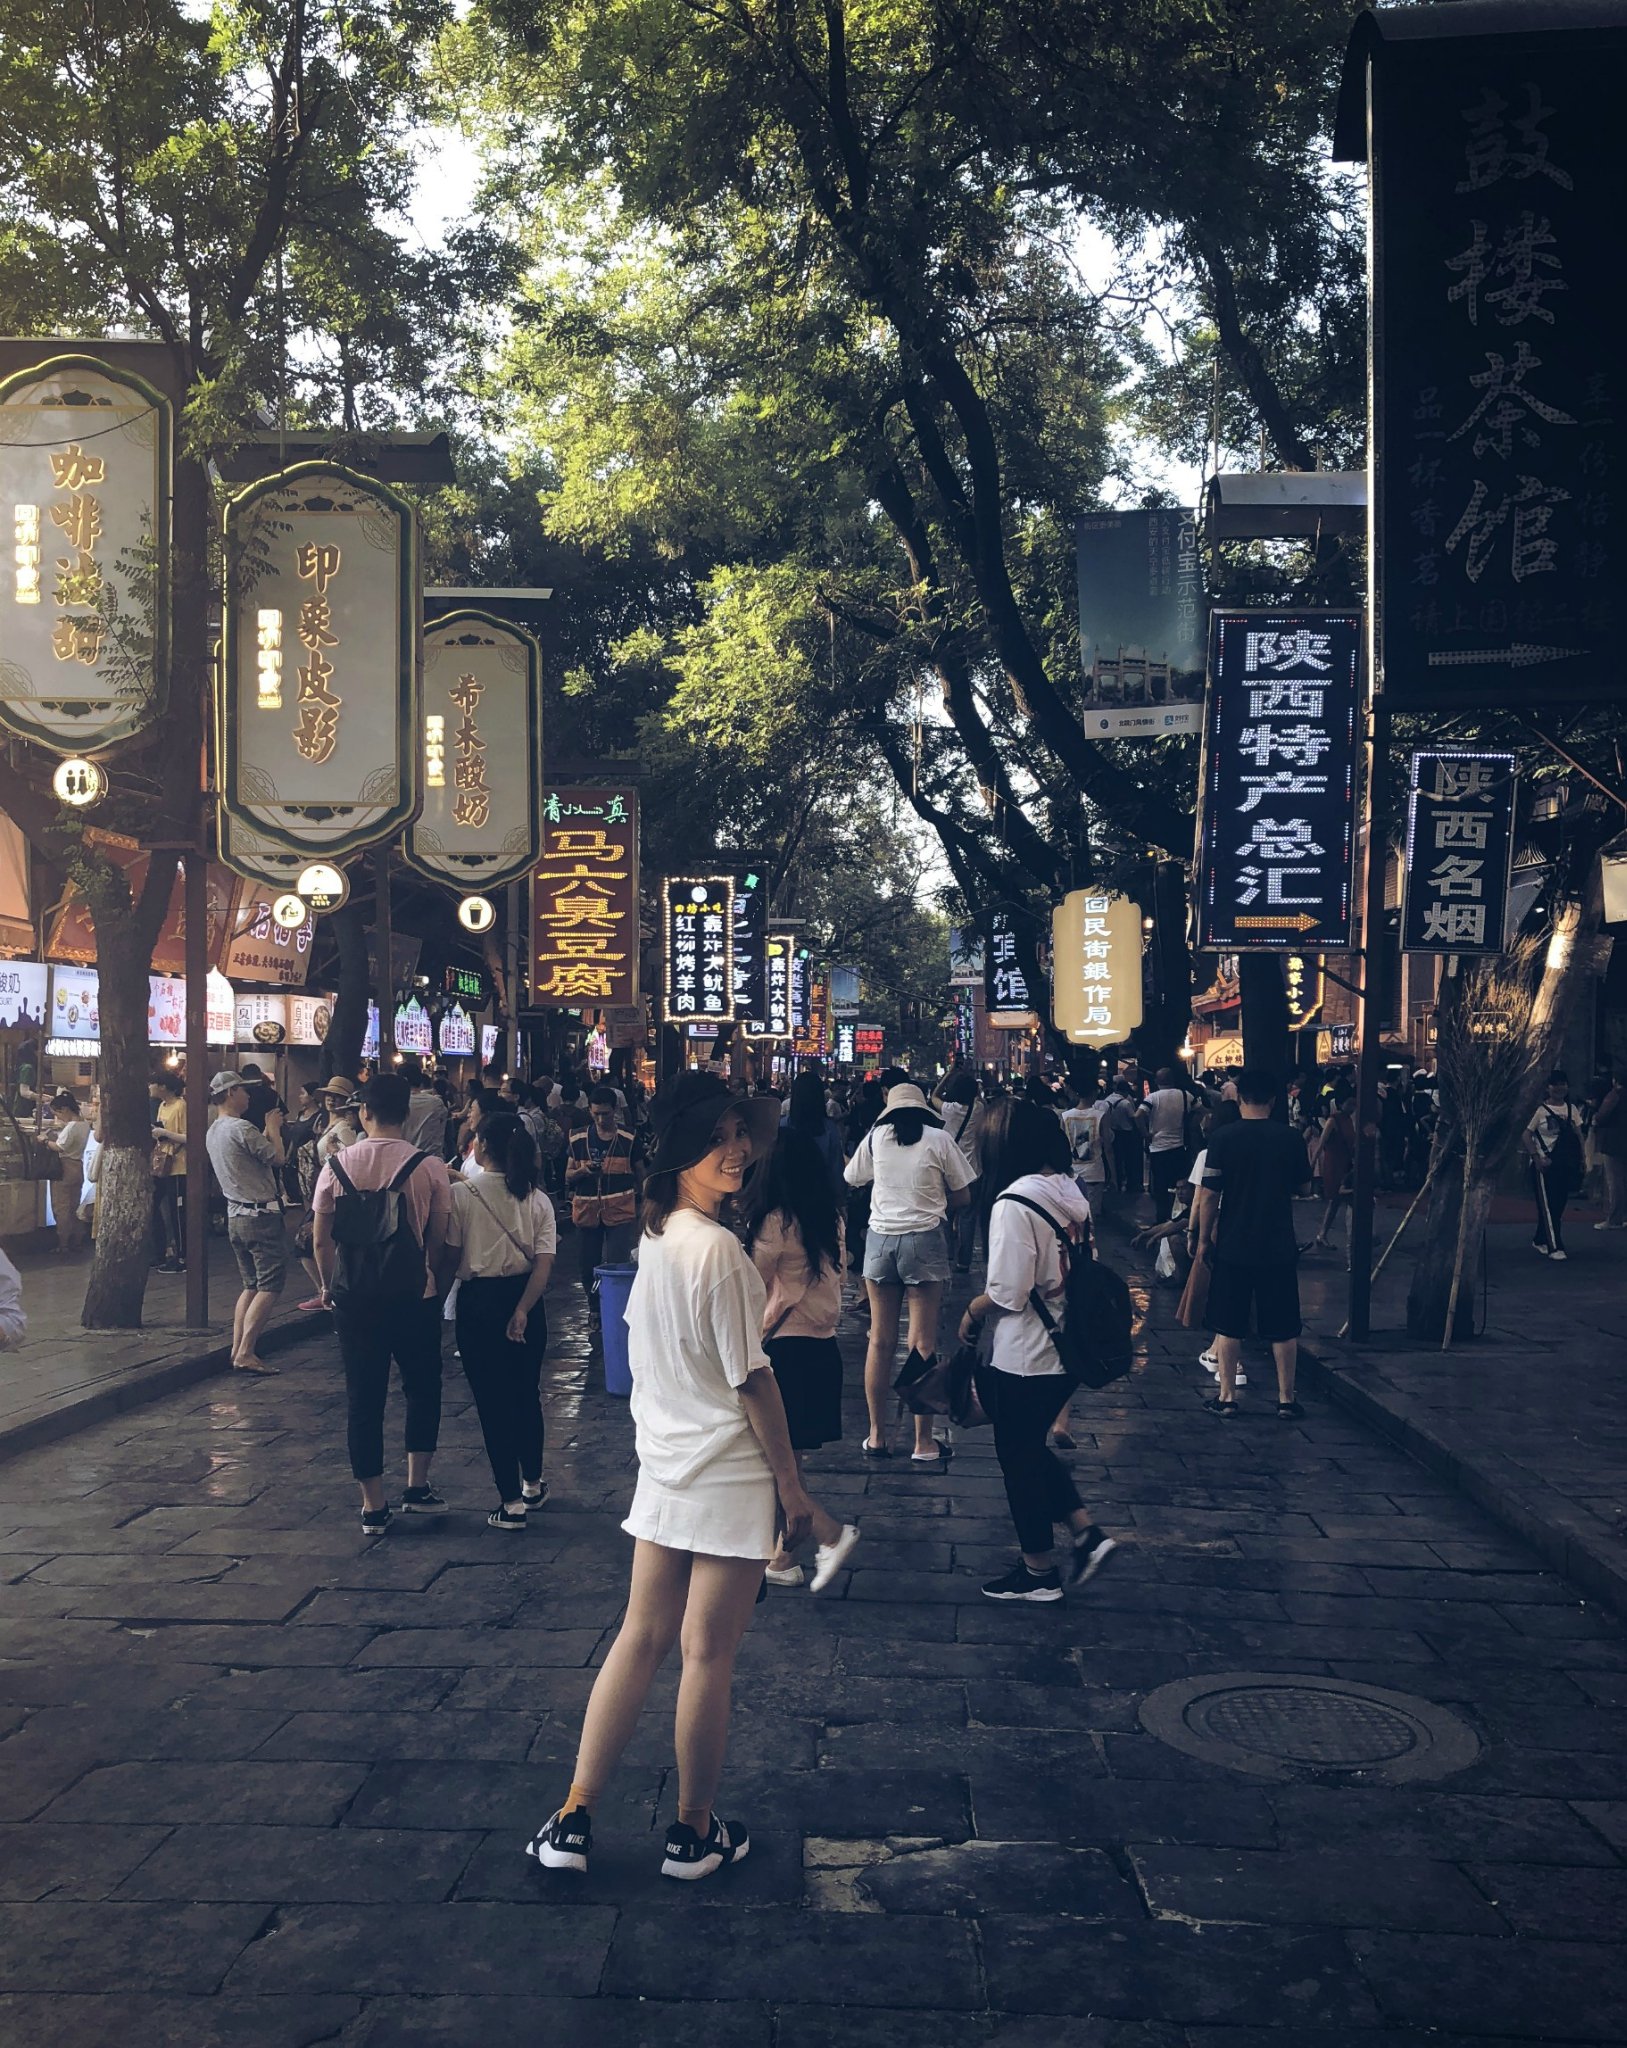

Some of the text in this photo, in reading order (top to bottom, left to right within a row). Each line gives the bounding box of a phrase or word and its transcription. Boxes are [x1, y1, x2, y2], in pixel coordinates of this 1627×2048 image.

[1445, 81, 1578, 583] 鼓楼茶馆
[449, 673, 491, 828] 希木酸奶
[1234, 629, 1334, 906] 陕西特产总汇
[537, 830, 629, 997] 马六臭豆腐
[1422, 761, 1495, 944] 陕西名烟
[675, 915, 696, 1011] 红柳烤羊肉
[703, 915, 724, 1011] 轰炸大鱿鱼
[771, 957, 786, 1032] 轰炸大鱿鱼
[1082, 896, 1112, 1025] 回民街銀作局
[565, 1833, 586, 1846] NIKE
[666, 1842, 682, 1855] NIKE
